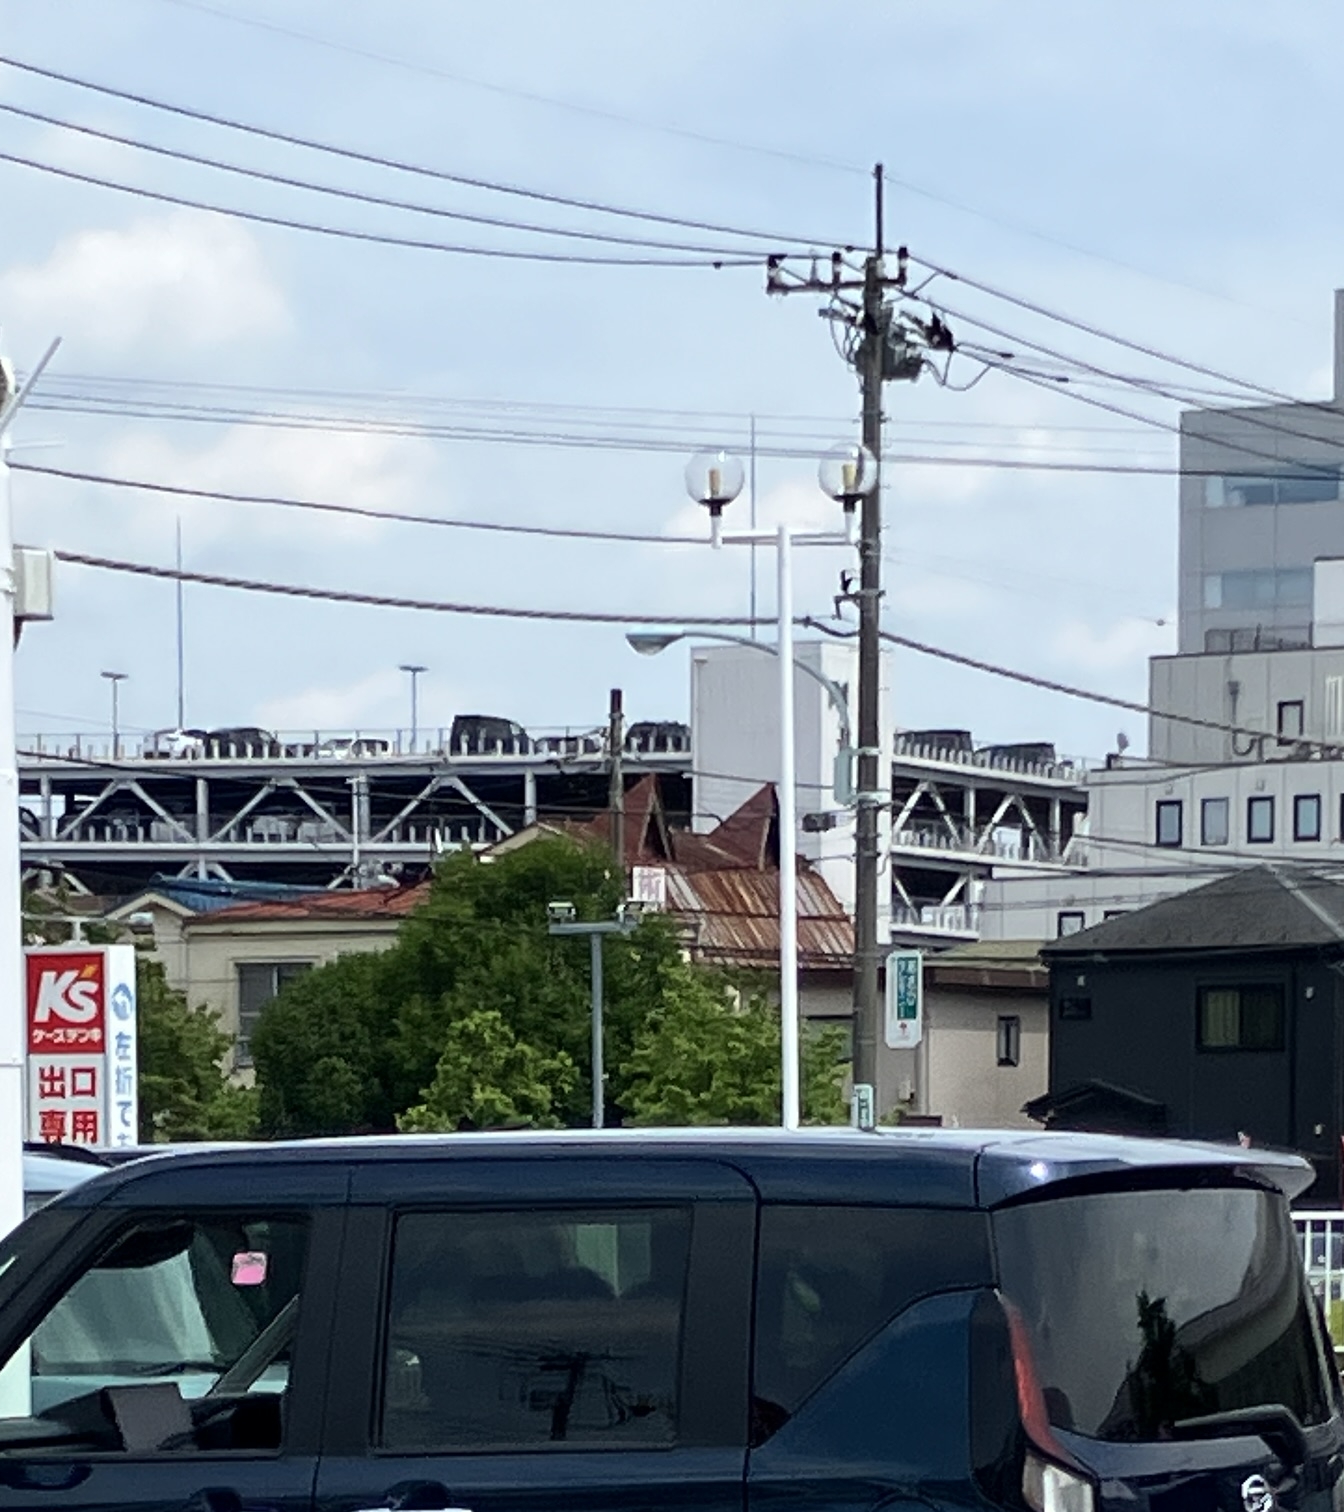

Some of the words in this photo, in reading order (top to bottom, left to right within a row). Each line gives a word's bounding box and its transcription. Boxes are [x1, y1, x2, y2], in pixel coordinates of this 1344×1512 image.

[33, 964, 99, 1024] K's
[39, 1065, 96, 1099] 出口
[39, 1110, 98, 1144] 専用
